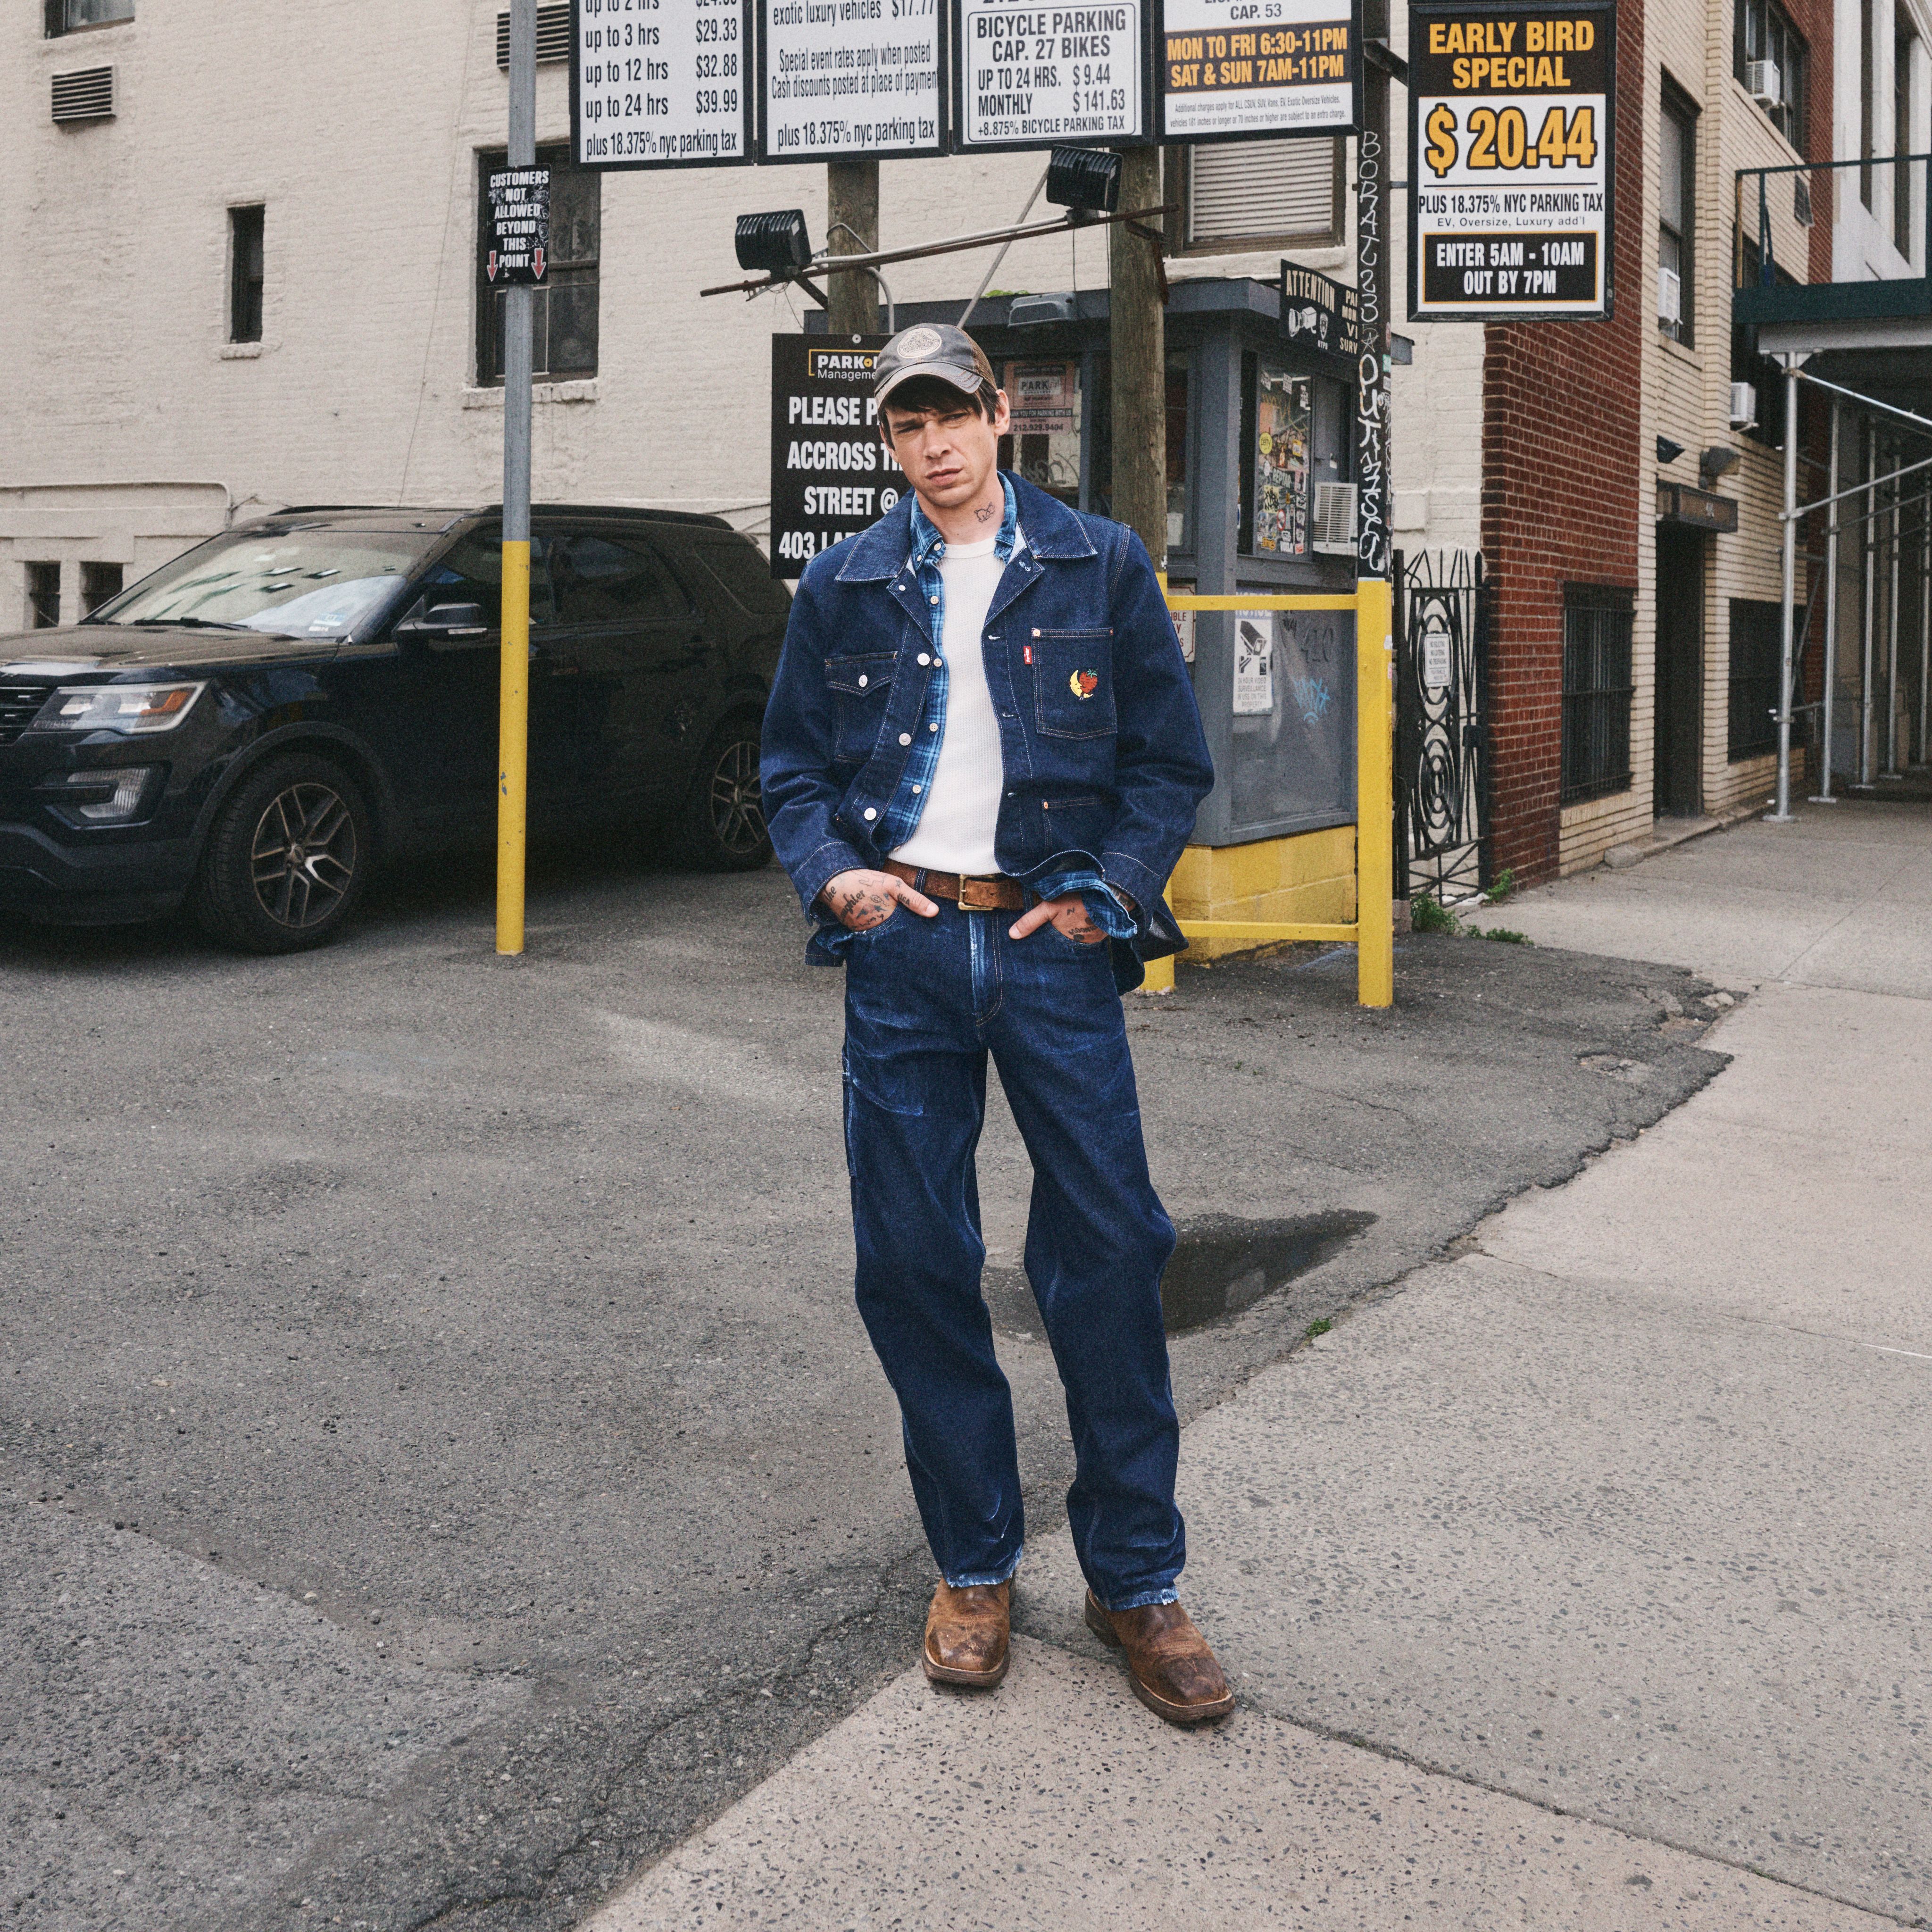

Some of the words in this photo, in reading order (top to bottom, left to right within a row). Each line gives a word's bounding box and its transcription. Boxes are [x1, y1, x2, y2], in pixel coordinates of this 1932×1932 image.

[774, 1, 802, 25] exotic
[807, 0, 836, 26] luxury
[840, 0, 881, 20] vehicles
[977, 14, 1046, 38] BICYCLE
[1053, 9, 1126, 33] PARKING
[1230, 5, 1260, 20] CAP.
[1266, 3, 1282, 17] 53
[586, 29, 601, 53] up
[607, 25, 619, 47] to
[625, 24, 633, 46] 3
[638, 23, 659, 45] hrs
[696, 17, 737, 46] $29.33
[1167, 37, 1203, 61] MON
[1206, 35, 1226, 58] TO
[1231, 33, 1256, 57] FRI
[1260, 27, 1348, 55] 6:30-11PM
[1430, 22, 1517, 54] EARLY
[1526, 21, 1594, 51] BIRD
[779, 48, 808, 75] Special
[811, 47, 832, 69] event
[835, 46, 854, 68] rates
[857, 43, 878, 71] apply
[881, 42, 901, 66] when
[905, 39, 930, 70] posted
[992, 40, 1029, 62] CAP.
[1035, 38, 1055, 60] 27
[1061, 35, 1110, 58] BIKES
[586, 65, 601, 88] up
[607, 60, 619, 82] to
[625, 58, 641, 81] 12
[647, 58, 668, 80] hrs
[696, 53, 737, 81] $32.88
[978, 69, 993, 91] UP
[998, 68, 1012, 89] TO
[1016, 67, 1030, 88] 24
[1034, 66, 1061, 87] HRS.
[1171, 64, 1199, 88] SAT
[1204, 63, 1216, 85] &
[1220, 60, 1252, 84] SUN
[1257, 54, 1344, 82] 7AM-11PM
[1453, 57, 1571, 89] SPECIAL
[772, 75, 791, 99] Cash
[793, 74, 830, 97] discounts
[833, 71, 858, 100] posted
[862, 70, 869, 93] at
[872, 69, 892, 98] place
[896, 68, 902, 92] of
[906, 71, 938, 96] paymen
[586, 99, 601, 123] up
[607, 96, 619, 117] to
[625, 94, 641, 116] 24
[647, 93, 668, 115] hrs
[696, 89, 737, 117] $39.99
[978, 93, 1033, 117] MONTHLY
[1175, 102, 1197, 113] Additional
[1198, 103, 1215, 113] charges
[1216, 101, 1227, 112] apply
[1235, 100, 1243, 109] ALL
[1302, 96, 1320, 106] Oversize
[978, 121, 1019, 136] +8.875%
[1022, 119, 1060, 133] BICYCLE
[1064, 117, 1104, 132] PARKING
[1108, 116, 1125, 130] TAX
[1170, 118, 1187, 127] vehicles
[1197, 117, 1211, 125] inches
[1218, 116, 1232, 126] longer
[1244, 115, 1258, 123] inches
[1266, 113, 1279, 123] higher
[1288, 111, 1304, 122] subject
[1305, 111, 1310, 119] to
[587, 133, 607, 161] plus
[610, 131, 657, 155] 18.375%
[660, 134, 676, 158] nyc
[680, 129, 717, 157] parking
[721, 129, 737, 151] tax
[778, 123, 799, 151] plus
[803, 120, 851, 145] 18.375%
[854, 123, 872, 147] nyc
[875, 117, 915, 146] parking
[919, 116, 934, 138] tax
[490, 171, 549, 188] CUSTOMERS
[506, 188, 527, 201] NOT
[1419, 195, 1447, 213] PLUS
[1451, 194, 1500, 214] 18.375%
[1504, 194, 1526, 212] NYC
[1531, 193, 1579, 212] PARKING
[1582, 193, 1603, 212] TAX
[495, 203, 541, 219] ALLOWED
[1437, 217, 1455, 227] EV,
[1460, 217, 1511, 227] Oversize,
[1516, 217, 1553, 228] Luxury
[496, 220, 536, 235] BEYOND
[503, 237, 526, 251] THIS
[1437, 243, 1484, 267] ENTER
[1490, 243, 1523, 266] 5AM
[1541, 242, 1584, 266] 10AM
[499, 254, 530, 268] POINT
[1286, 270, 1334, 313] ATTENTION
[1464, 271, 1493, 294] OUT
[1498, 271, 1518, 293] BY
[1524, 270, 1556, 293] 7PM
[818, 369, 875, 382] Manageme
[1022, 381, 1048, 390] PARK
[789, 396, 860, 425] PLEASE
[787, 441, 876, 471] ACCROSS
[804, 486, 875, 516] STREET
[880, 488, 899, 515] @
[779, 532, 815, 559] 403
